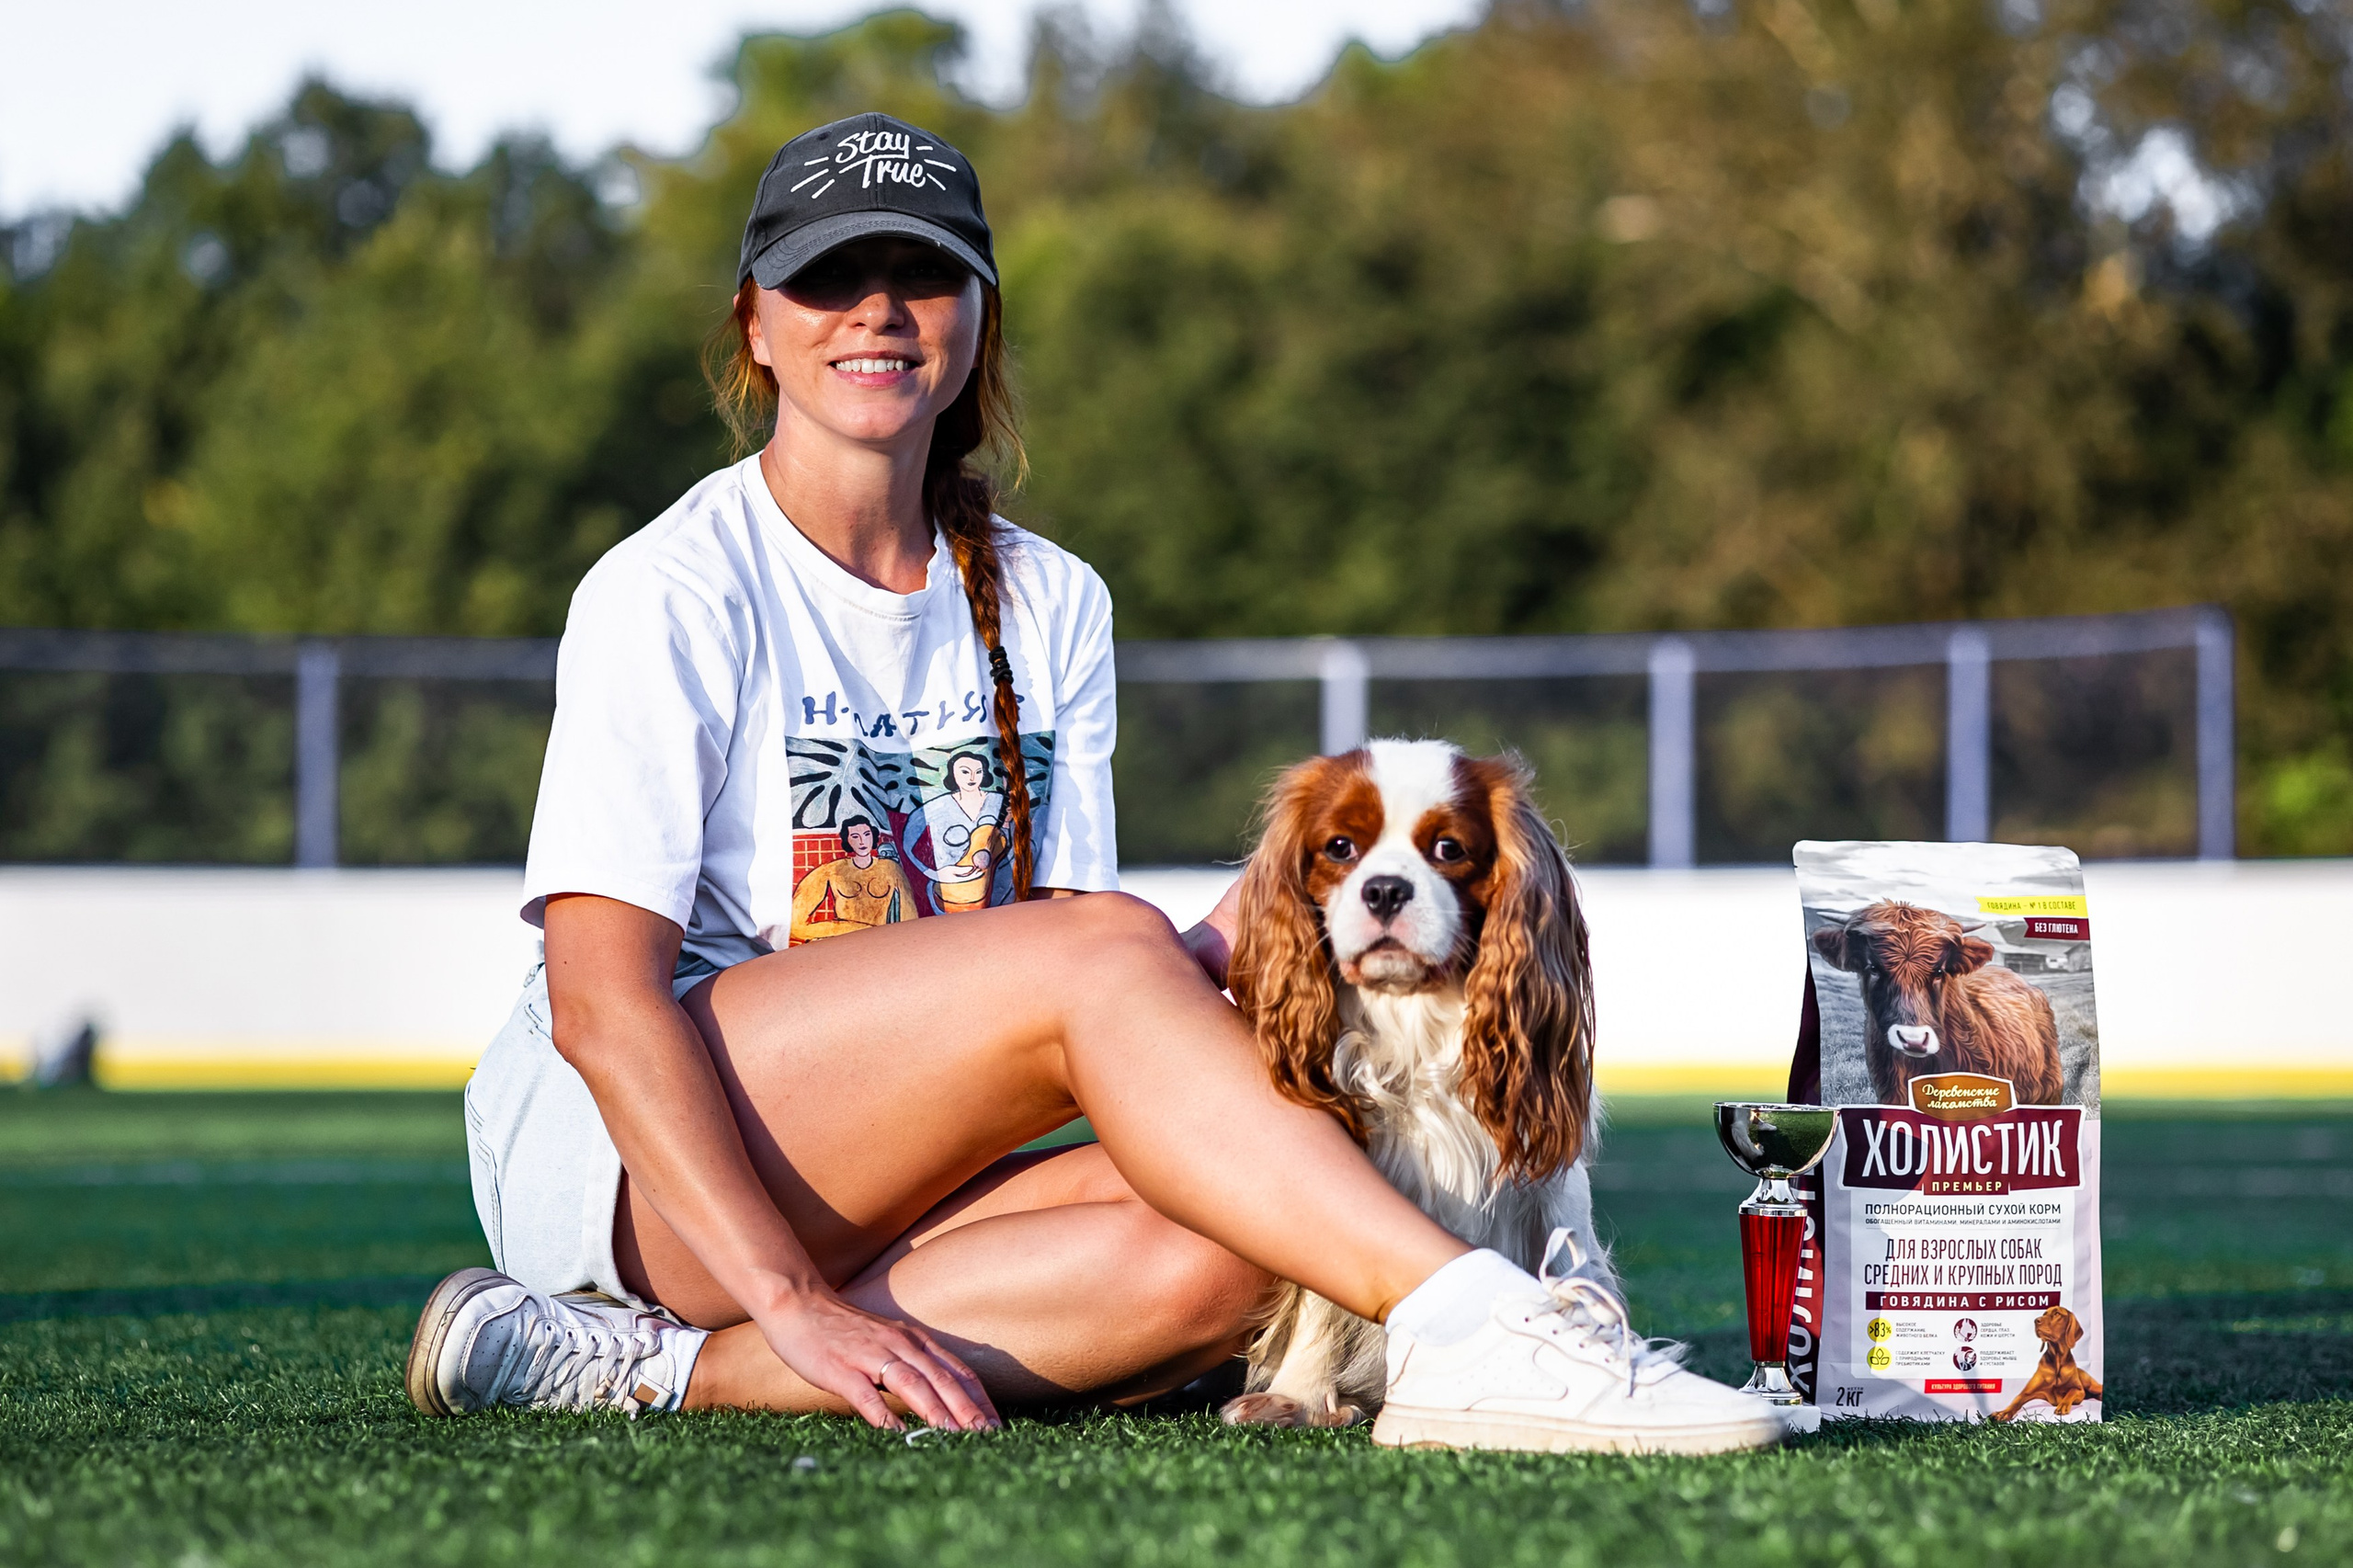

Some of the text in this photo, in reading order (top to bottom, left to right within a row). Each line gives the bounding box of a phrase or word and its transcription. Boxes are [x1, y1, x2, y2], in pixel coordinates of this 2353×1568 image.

[835, 131, 911, 164] Stay
[838, 154, 926, 188] True
[1986, 902, 2021, 911] ГОВЯДИНА
[2048, 901, 2077, 910] СОСТАВЕ
[2034, 922, 2078, 934] БЕЗ ГЛЮТЕНА
[1922, 1084, 2000, 1101] Деревенские
[1927, 1096, 1997, 1109] лакомства
[1861, 1119, 2066, 1177] ХОЛИСТИК
[1932, 1181, 2003, 1192] ПРЕМЬЕР
[1865, 1202, 2061, 1216] ПОЛНОРАЦИОННЫЙ СУХОЙ КОРМ
[1885, 1238, 2042, 1261] ДЛЯ ВЗРОСЛЫХ СОБАК
[1864, 1264, 2062, 1287] СРЕДНИХ И КРУПНЫХ ПОРОД
[1880, 1295, 2050, 1308] ГОВЯДИНА С РИСОМ
